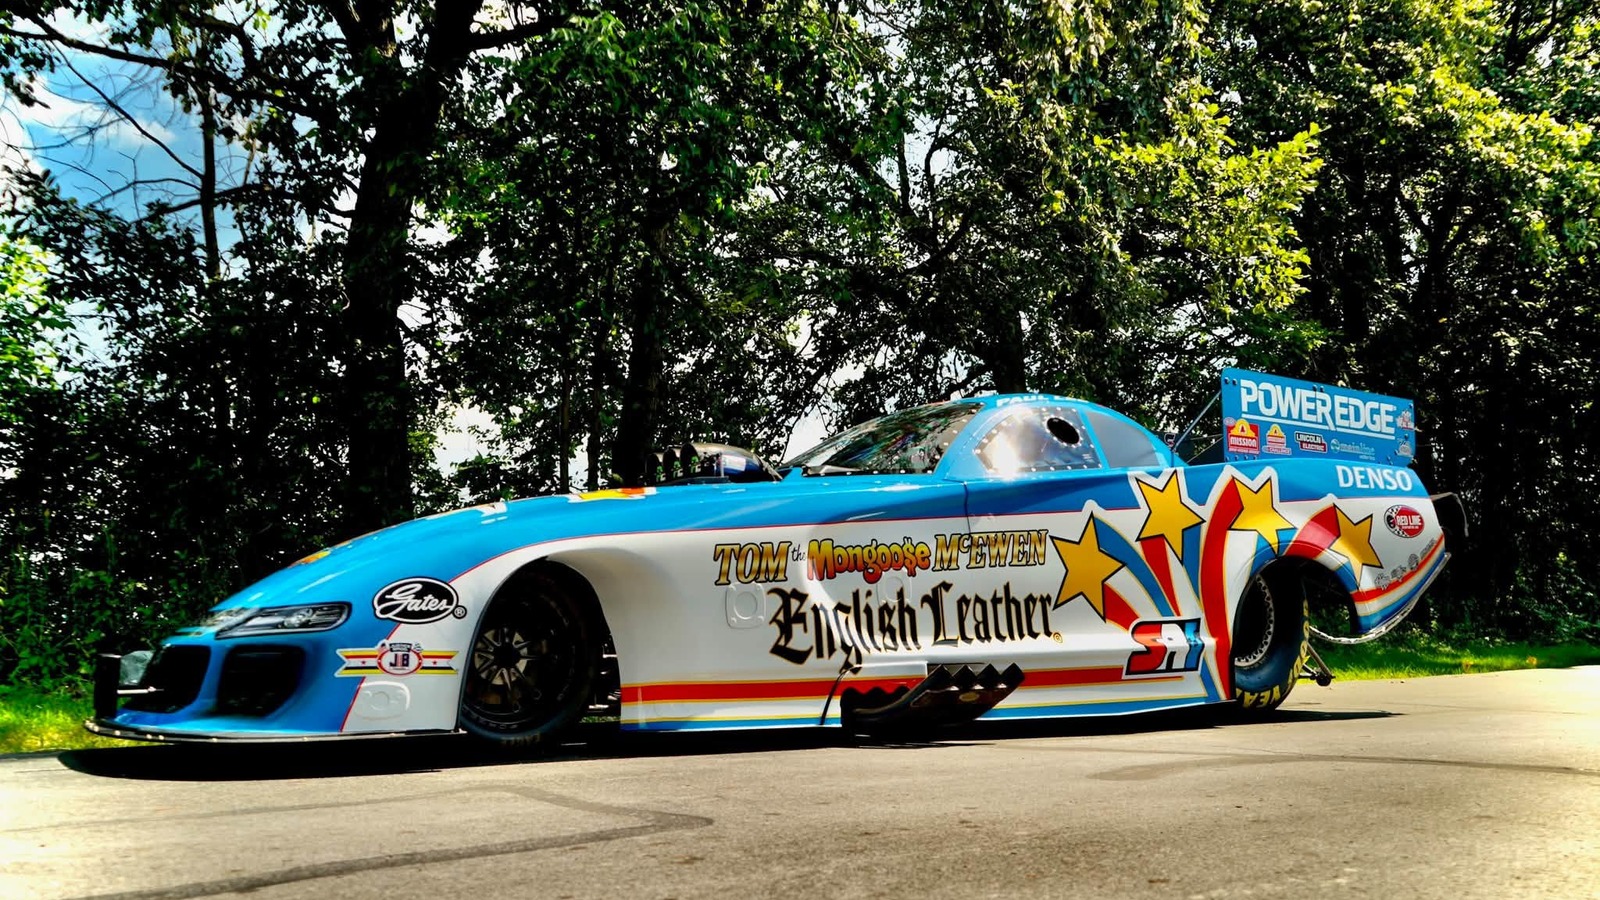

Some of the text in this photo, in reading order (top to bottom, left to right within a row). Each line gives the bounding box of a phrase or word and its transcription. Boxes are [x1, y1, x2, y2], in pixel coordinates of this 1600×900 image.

[1240, 378, 1396, 434] POWEREDGE
[1296, 433, 1322, 443] LINCOLN
[1302, 442, 1325, 451] ELECTRIC
[1336, 465, 1412, 492] DENSO
[1396, 515, 1422, 525] RED LINE
[714, 541, 792, 585] TOM
[376, 583, 453, 618] Gates
[767, 581, 1054, 675] English Leather
